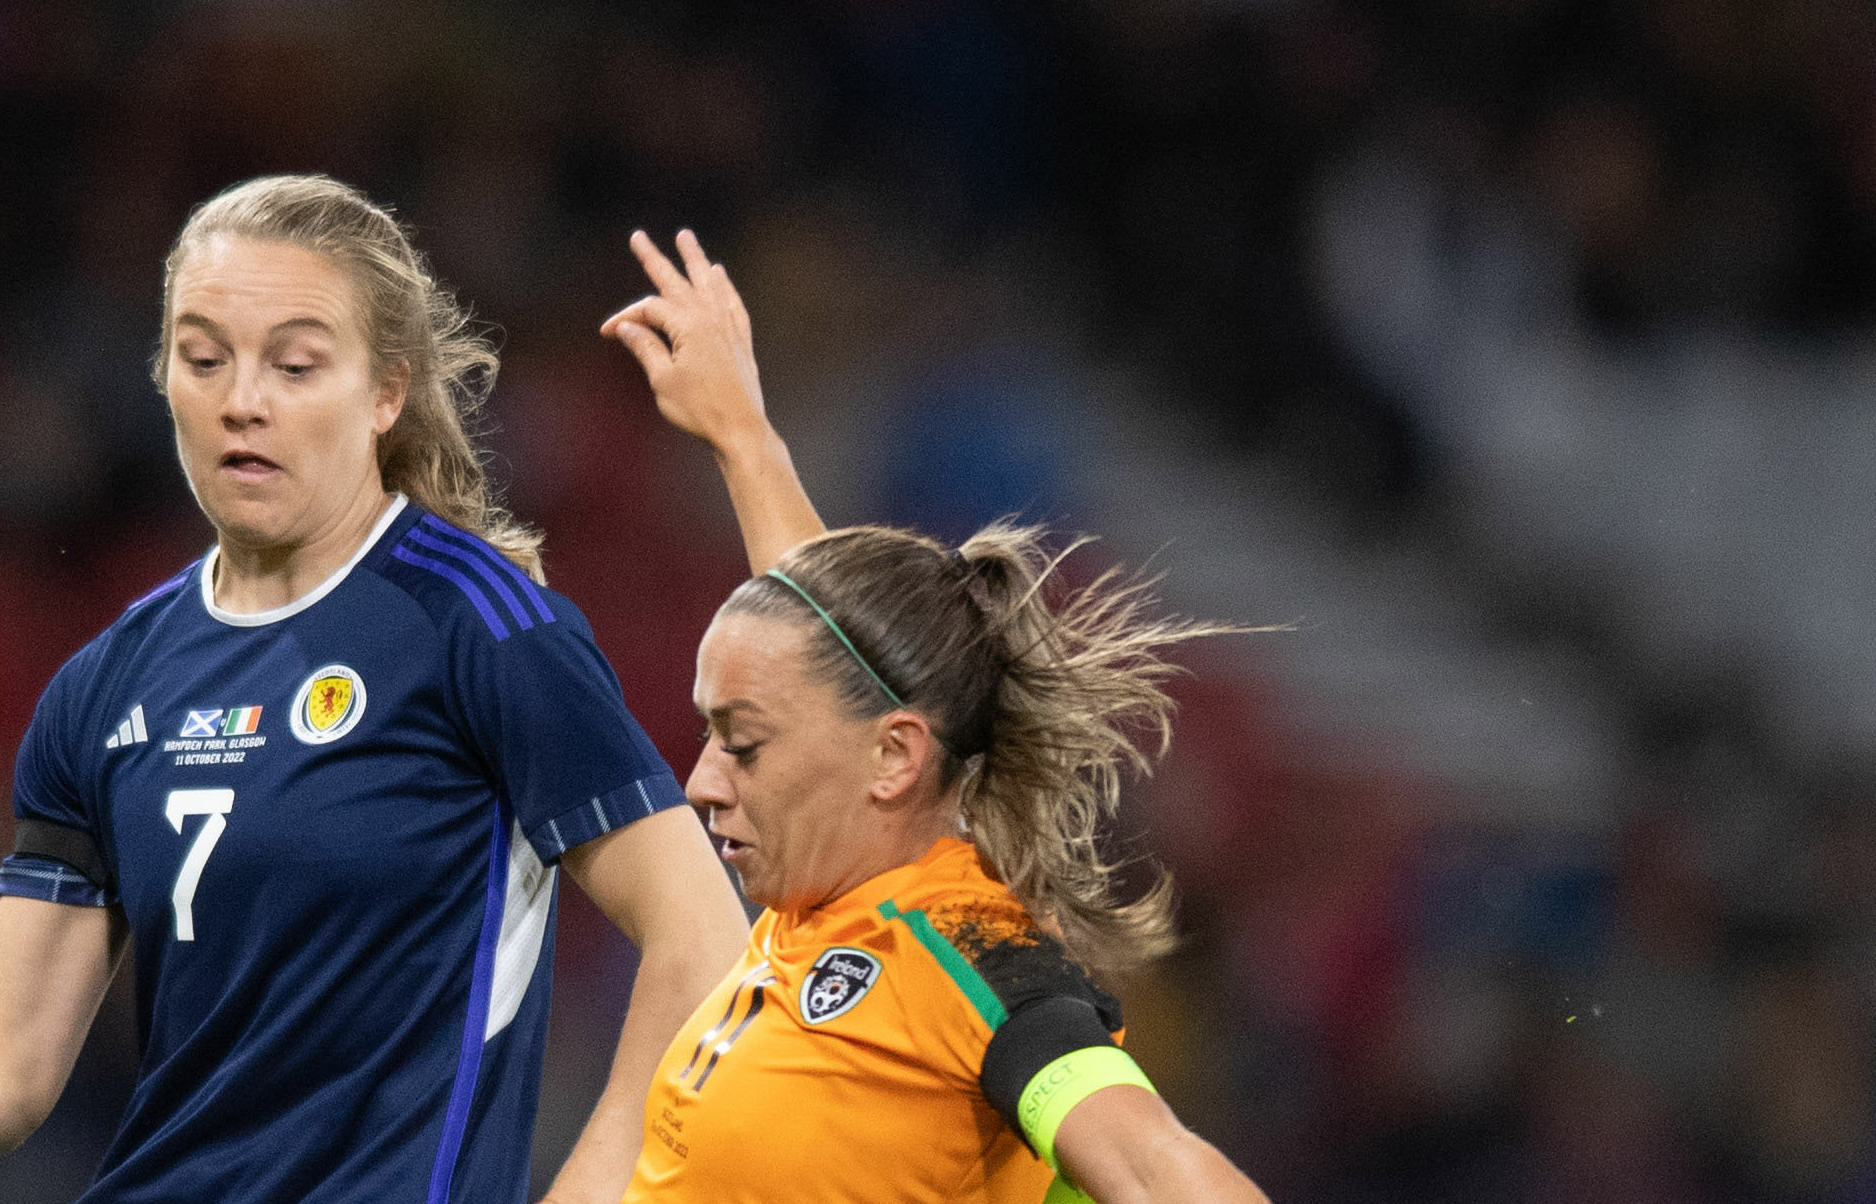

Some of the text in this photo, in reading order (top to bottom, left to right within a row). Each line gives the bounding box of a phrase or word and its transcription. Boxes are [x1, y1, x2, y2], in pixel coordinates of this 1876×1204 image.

[164, 741, 203, 752] HAMPDEN
[229, 736, 267, 749] GLASGOW
[175, 752, 246, 766] 11 OCTOBER 2022
[165, 788, 235, 941] 7
